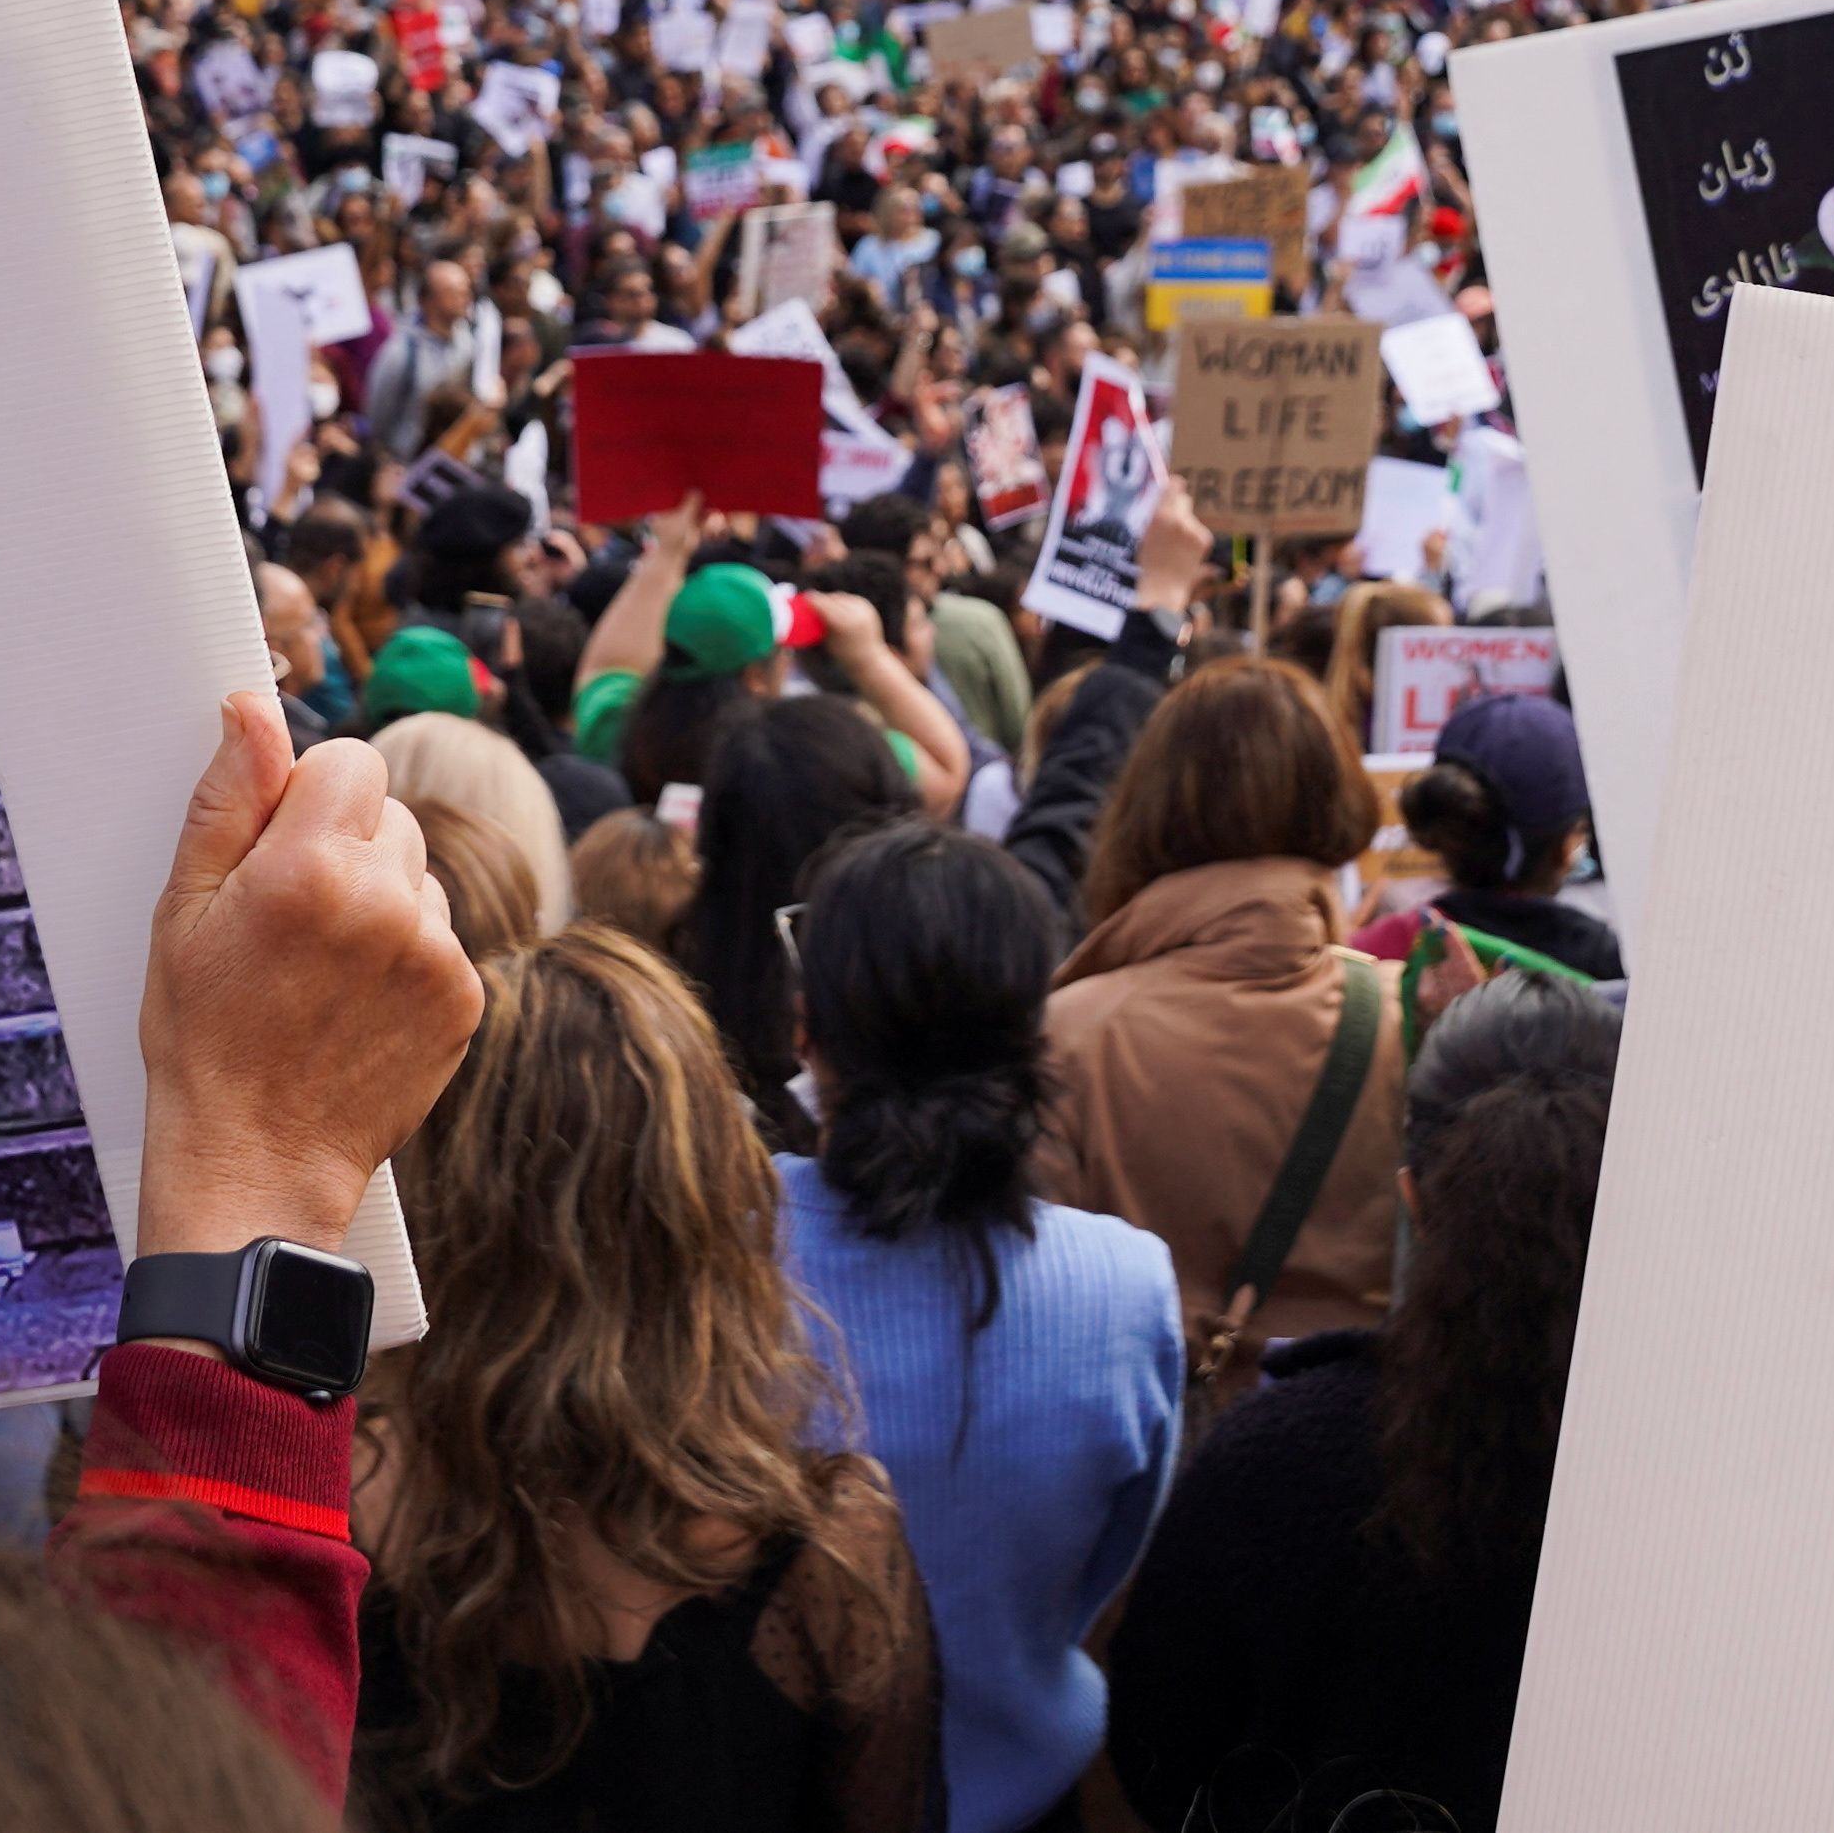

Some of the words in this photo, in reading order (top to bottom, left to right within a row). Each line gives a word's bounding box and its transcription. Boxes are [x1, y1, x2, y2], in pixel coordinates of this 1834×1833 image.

[1704, 32, 1752, 87] ژن
[1698, 139, 1776, 201] ژیان
[1193, 335, 1361, 381] WOMAN
[1223, 395, 1328, 440] LIFE
[1403, 637, 1553, 661] WOMEN
